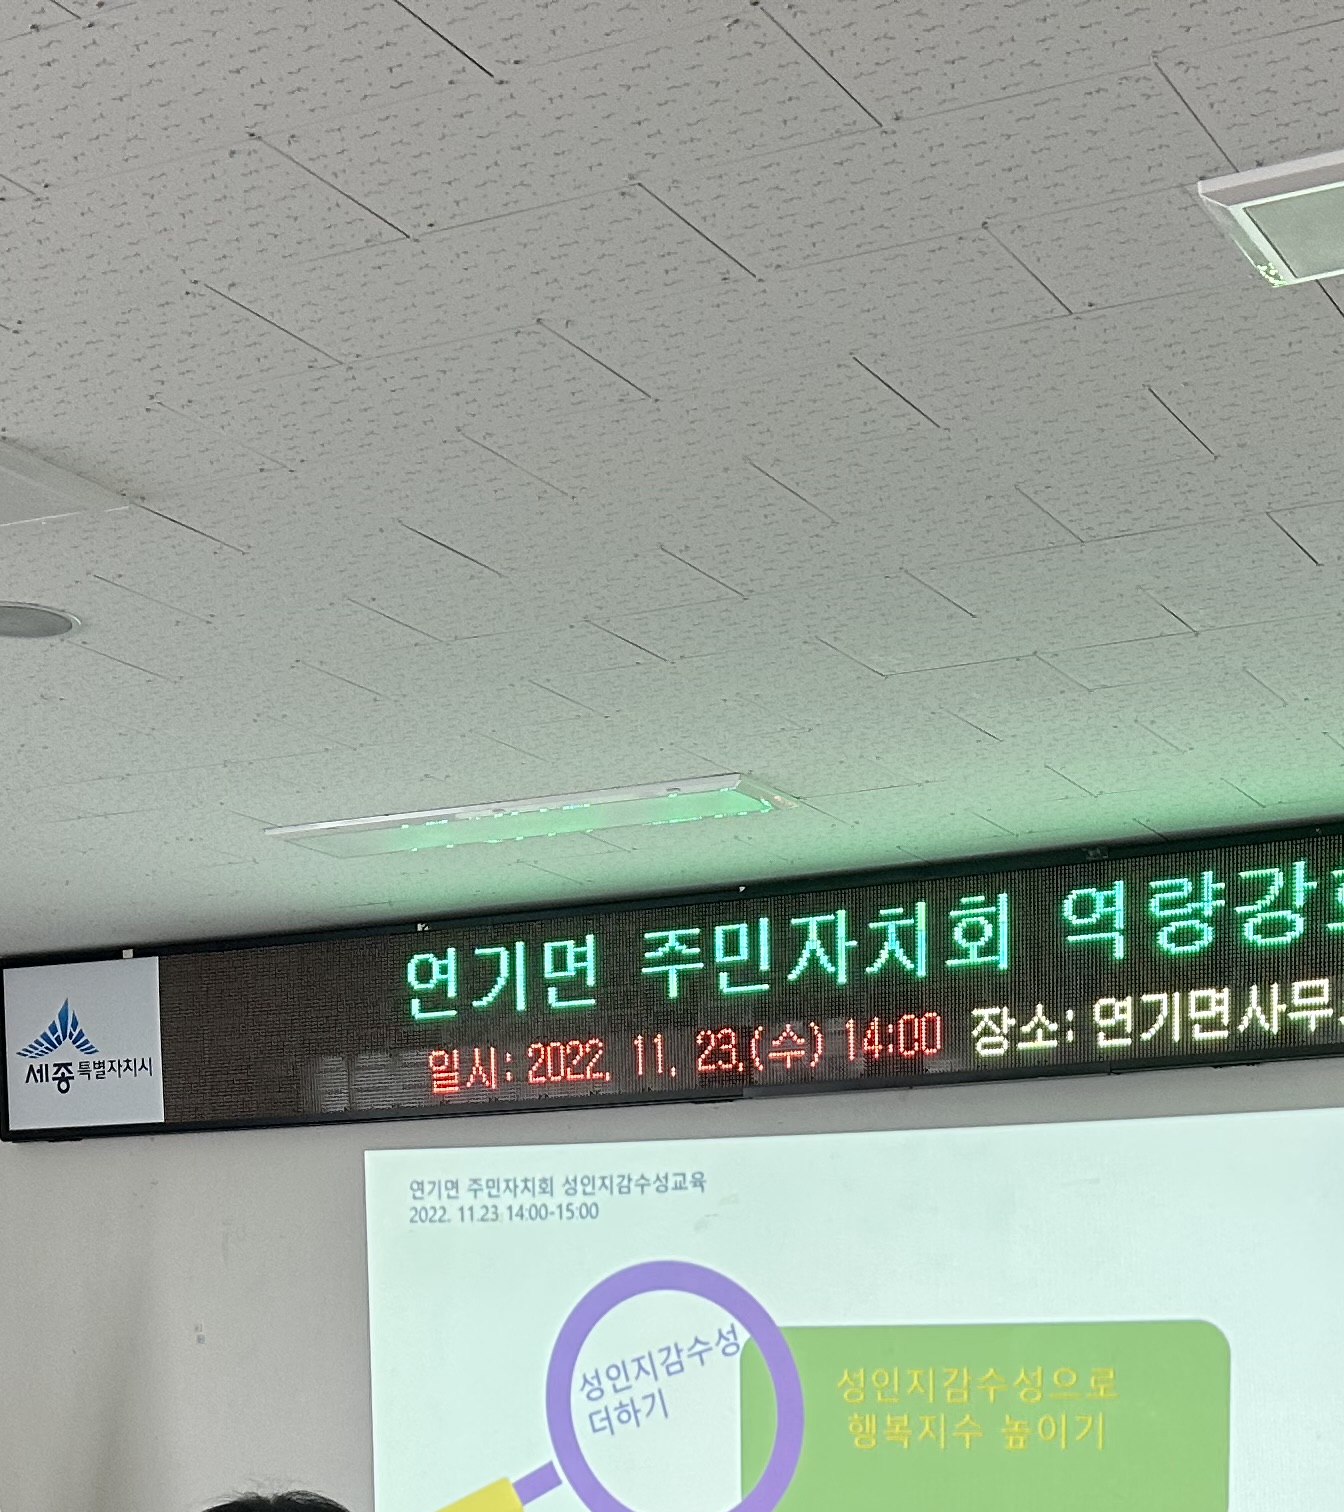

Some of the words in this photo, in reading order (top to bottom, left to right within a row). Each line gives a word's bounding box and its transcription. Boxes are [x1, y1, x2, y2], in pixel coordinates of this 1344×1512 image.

[406, 932, 597, 1020] 연기면
[641, 892, 1009, 999] 주민자치회
[428, 1046, 513, 1096] 일시:
[844, 1012, 943, 1063] 14:00
[970, 1002, 1074, 1056] 장소:
[408, 1178, 460, 1201] 연기면
[467, 1175, 555, 1199] 주민자치회
[562, 1170, 708, 1197] 성인지감수성교육
[408, 1205, 452, 1224] 2022.
[505, 1201, 600, 1222] 14:00-15:00
[579, 1322, 742, 1403] 성인지감수성
[837, 1365, 1119, 1404] 성인지감수성으로
[588, 1388, 670, 1438] 더하기
[847, 1412, 984, 1451] 행복지수
[1000, 1411, 1105, 1451] 높이기
